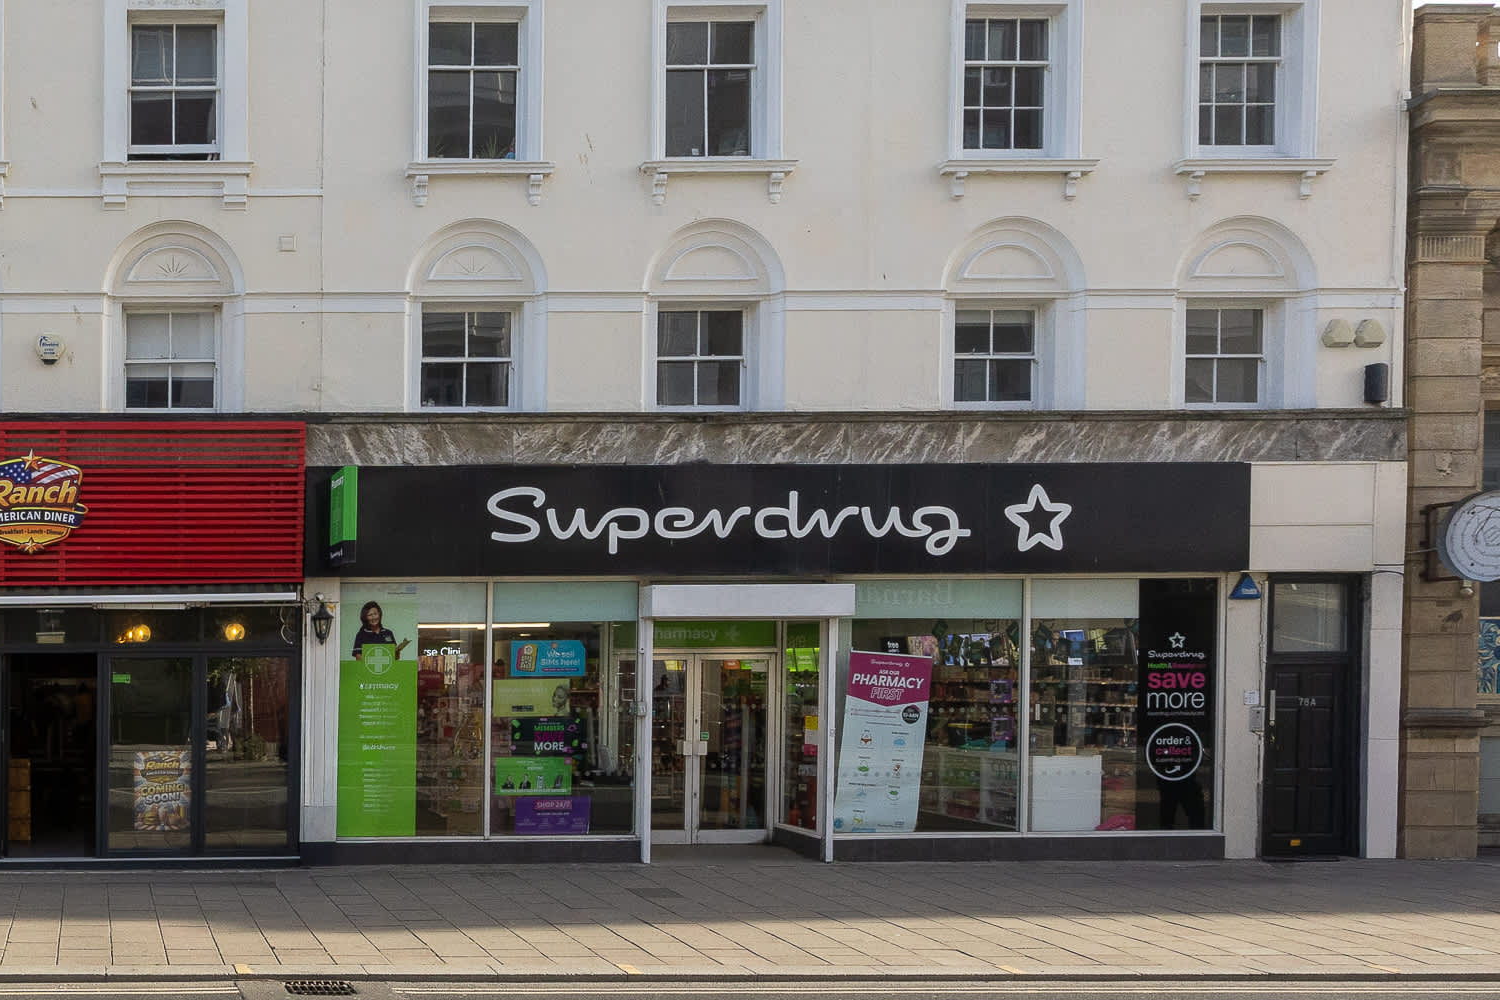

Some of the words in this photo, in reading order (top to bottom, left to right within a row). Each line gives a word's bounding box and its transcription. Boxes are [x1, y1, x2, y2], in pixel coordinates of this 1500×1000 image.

[44, 511, 76, 524] DINER
[487, 486, 971, 556] Superdrug
[1148, 650, 1205, 660] Superdrug
[852, 673, 924, 689] PHARMACY
[1147, 672, 1205, 689] save
[870, 687, 904, 700] FIRST
[1147, 692, 1205, 709] more
[534, 731, 564, 742] SAVE
[1155, 736, 1184, 745] order
[534, 742, 565, 751] MORE
[1155, 746, 1192, 755] collect
[146, 761, 180, 770] Ranch
[140, 784, 184, 797] COMING
[145, 792, 181, 804] SOON!
[537, 801, 555, 809] SHOP
